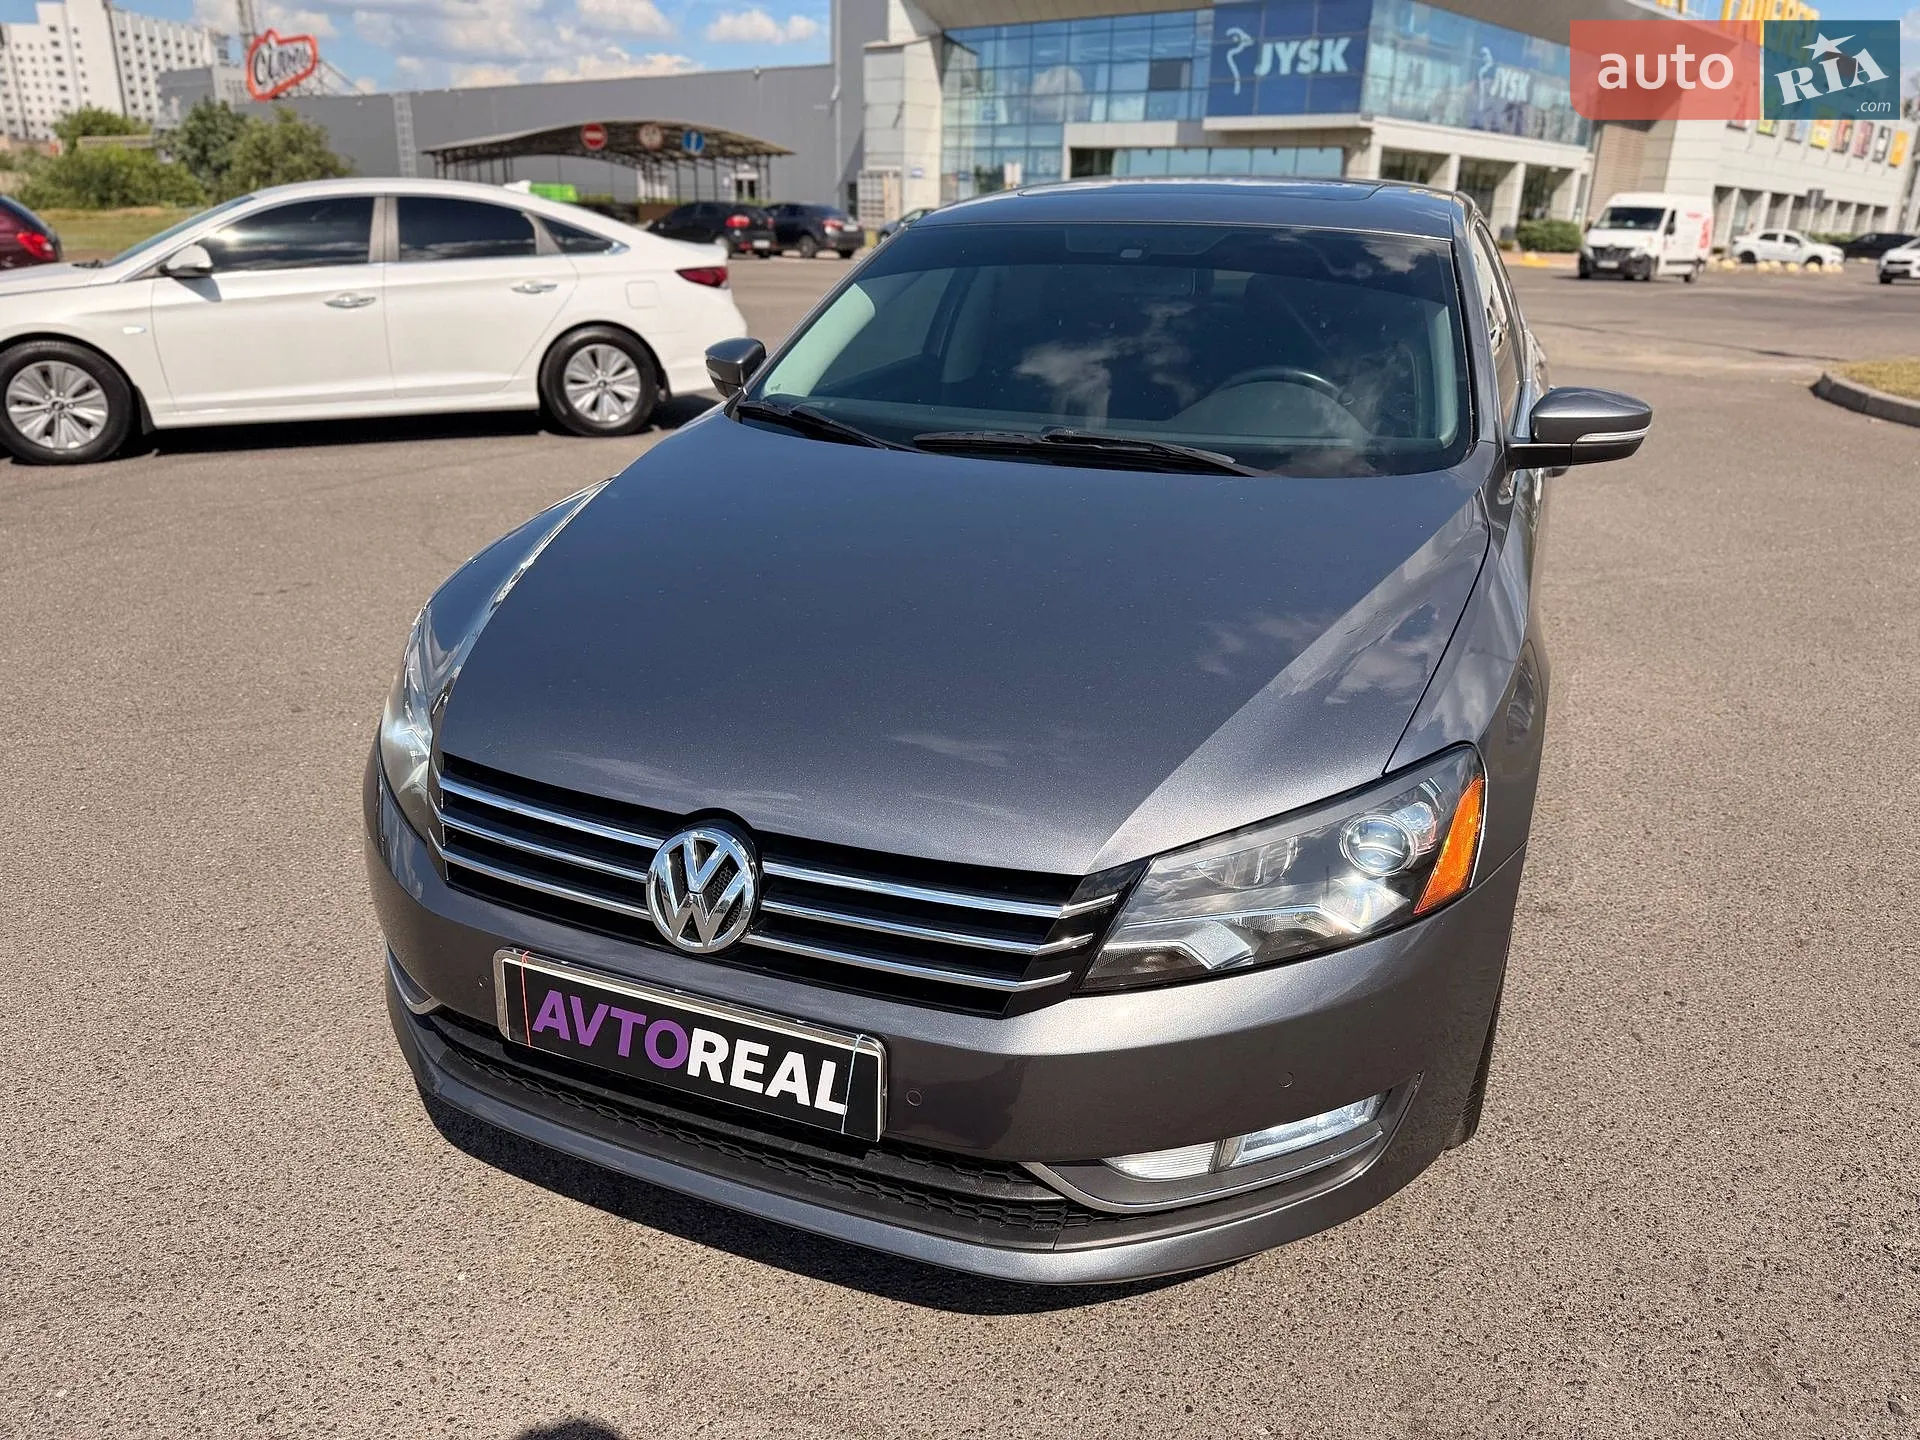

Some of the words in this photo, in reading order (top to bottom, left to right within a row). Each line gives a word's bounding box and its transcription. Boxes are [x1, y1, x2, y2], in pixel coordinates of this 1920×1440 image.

[1254, 37, 1351, 76] JYSK
[1490, 67, 1531, 102] JYSK
[531, 989, 848, 1115] AVTOREAL
